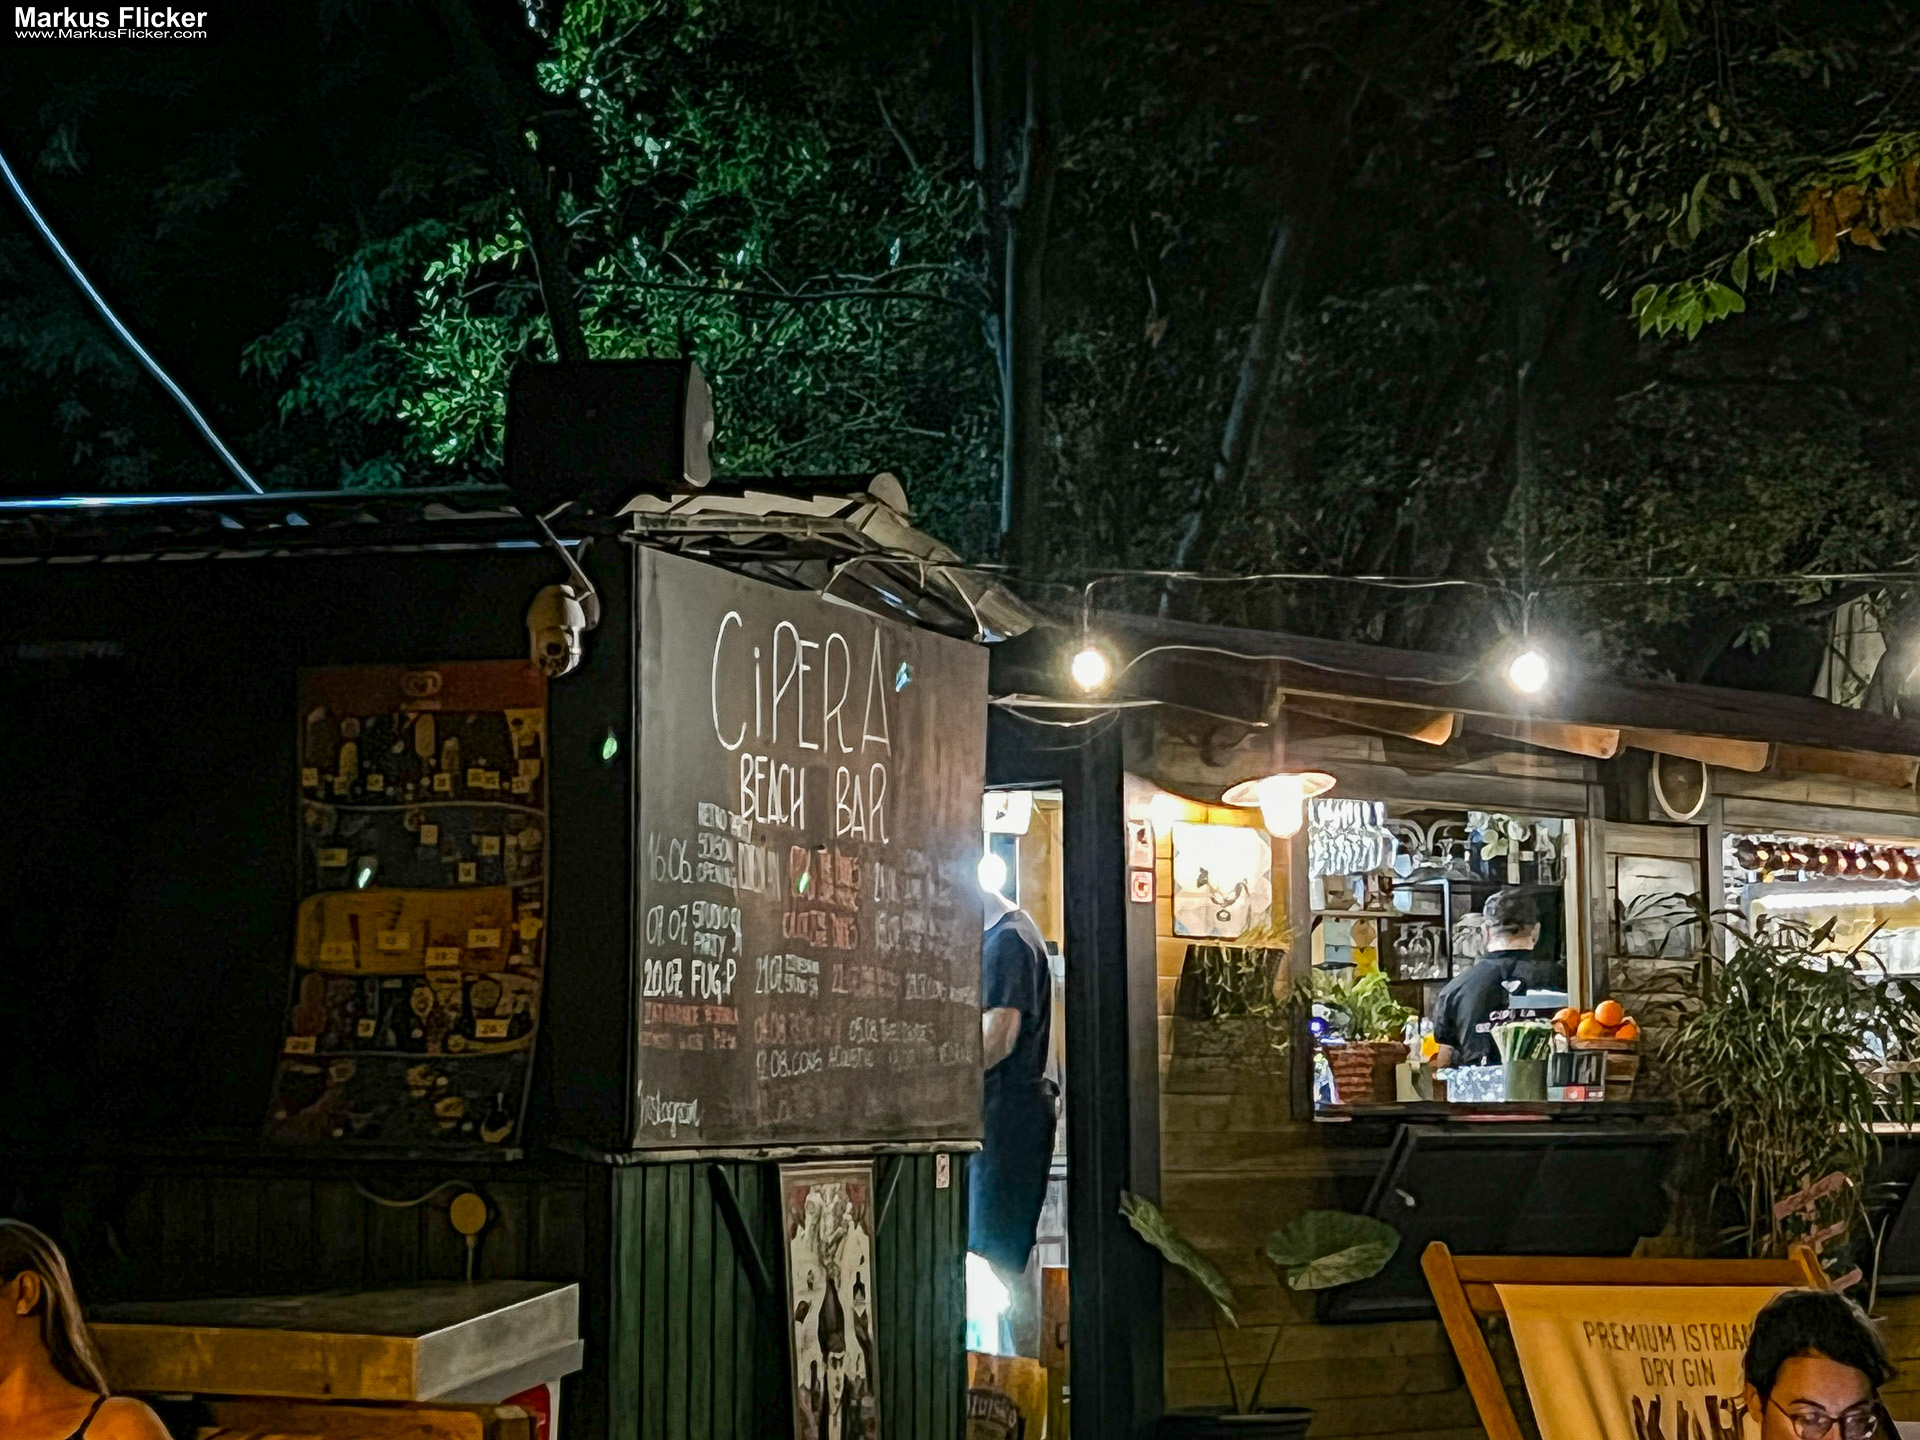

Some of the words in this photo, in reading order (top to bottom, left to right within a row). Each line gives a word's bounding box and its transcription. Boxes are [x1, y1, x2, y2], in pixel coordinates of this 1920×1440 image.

[740, 753, 805, 830] BEACH
[836, 763, 889, 844] BAR
[1583, 1321, 1676, 1352] PREMIUM
[1641, 1357, 1676, 1387] DRY
[1682, 1356, 1716, 1387] GIN
